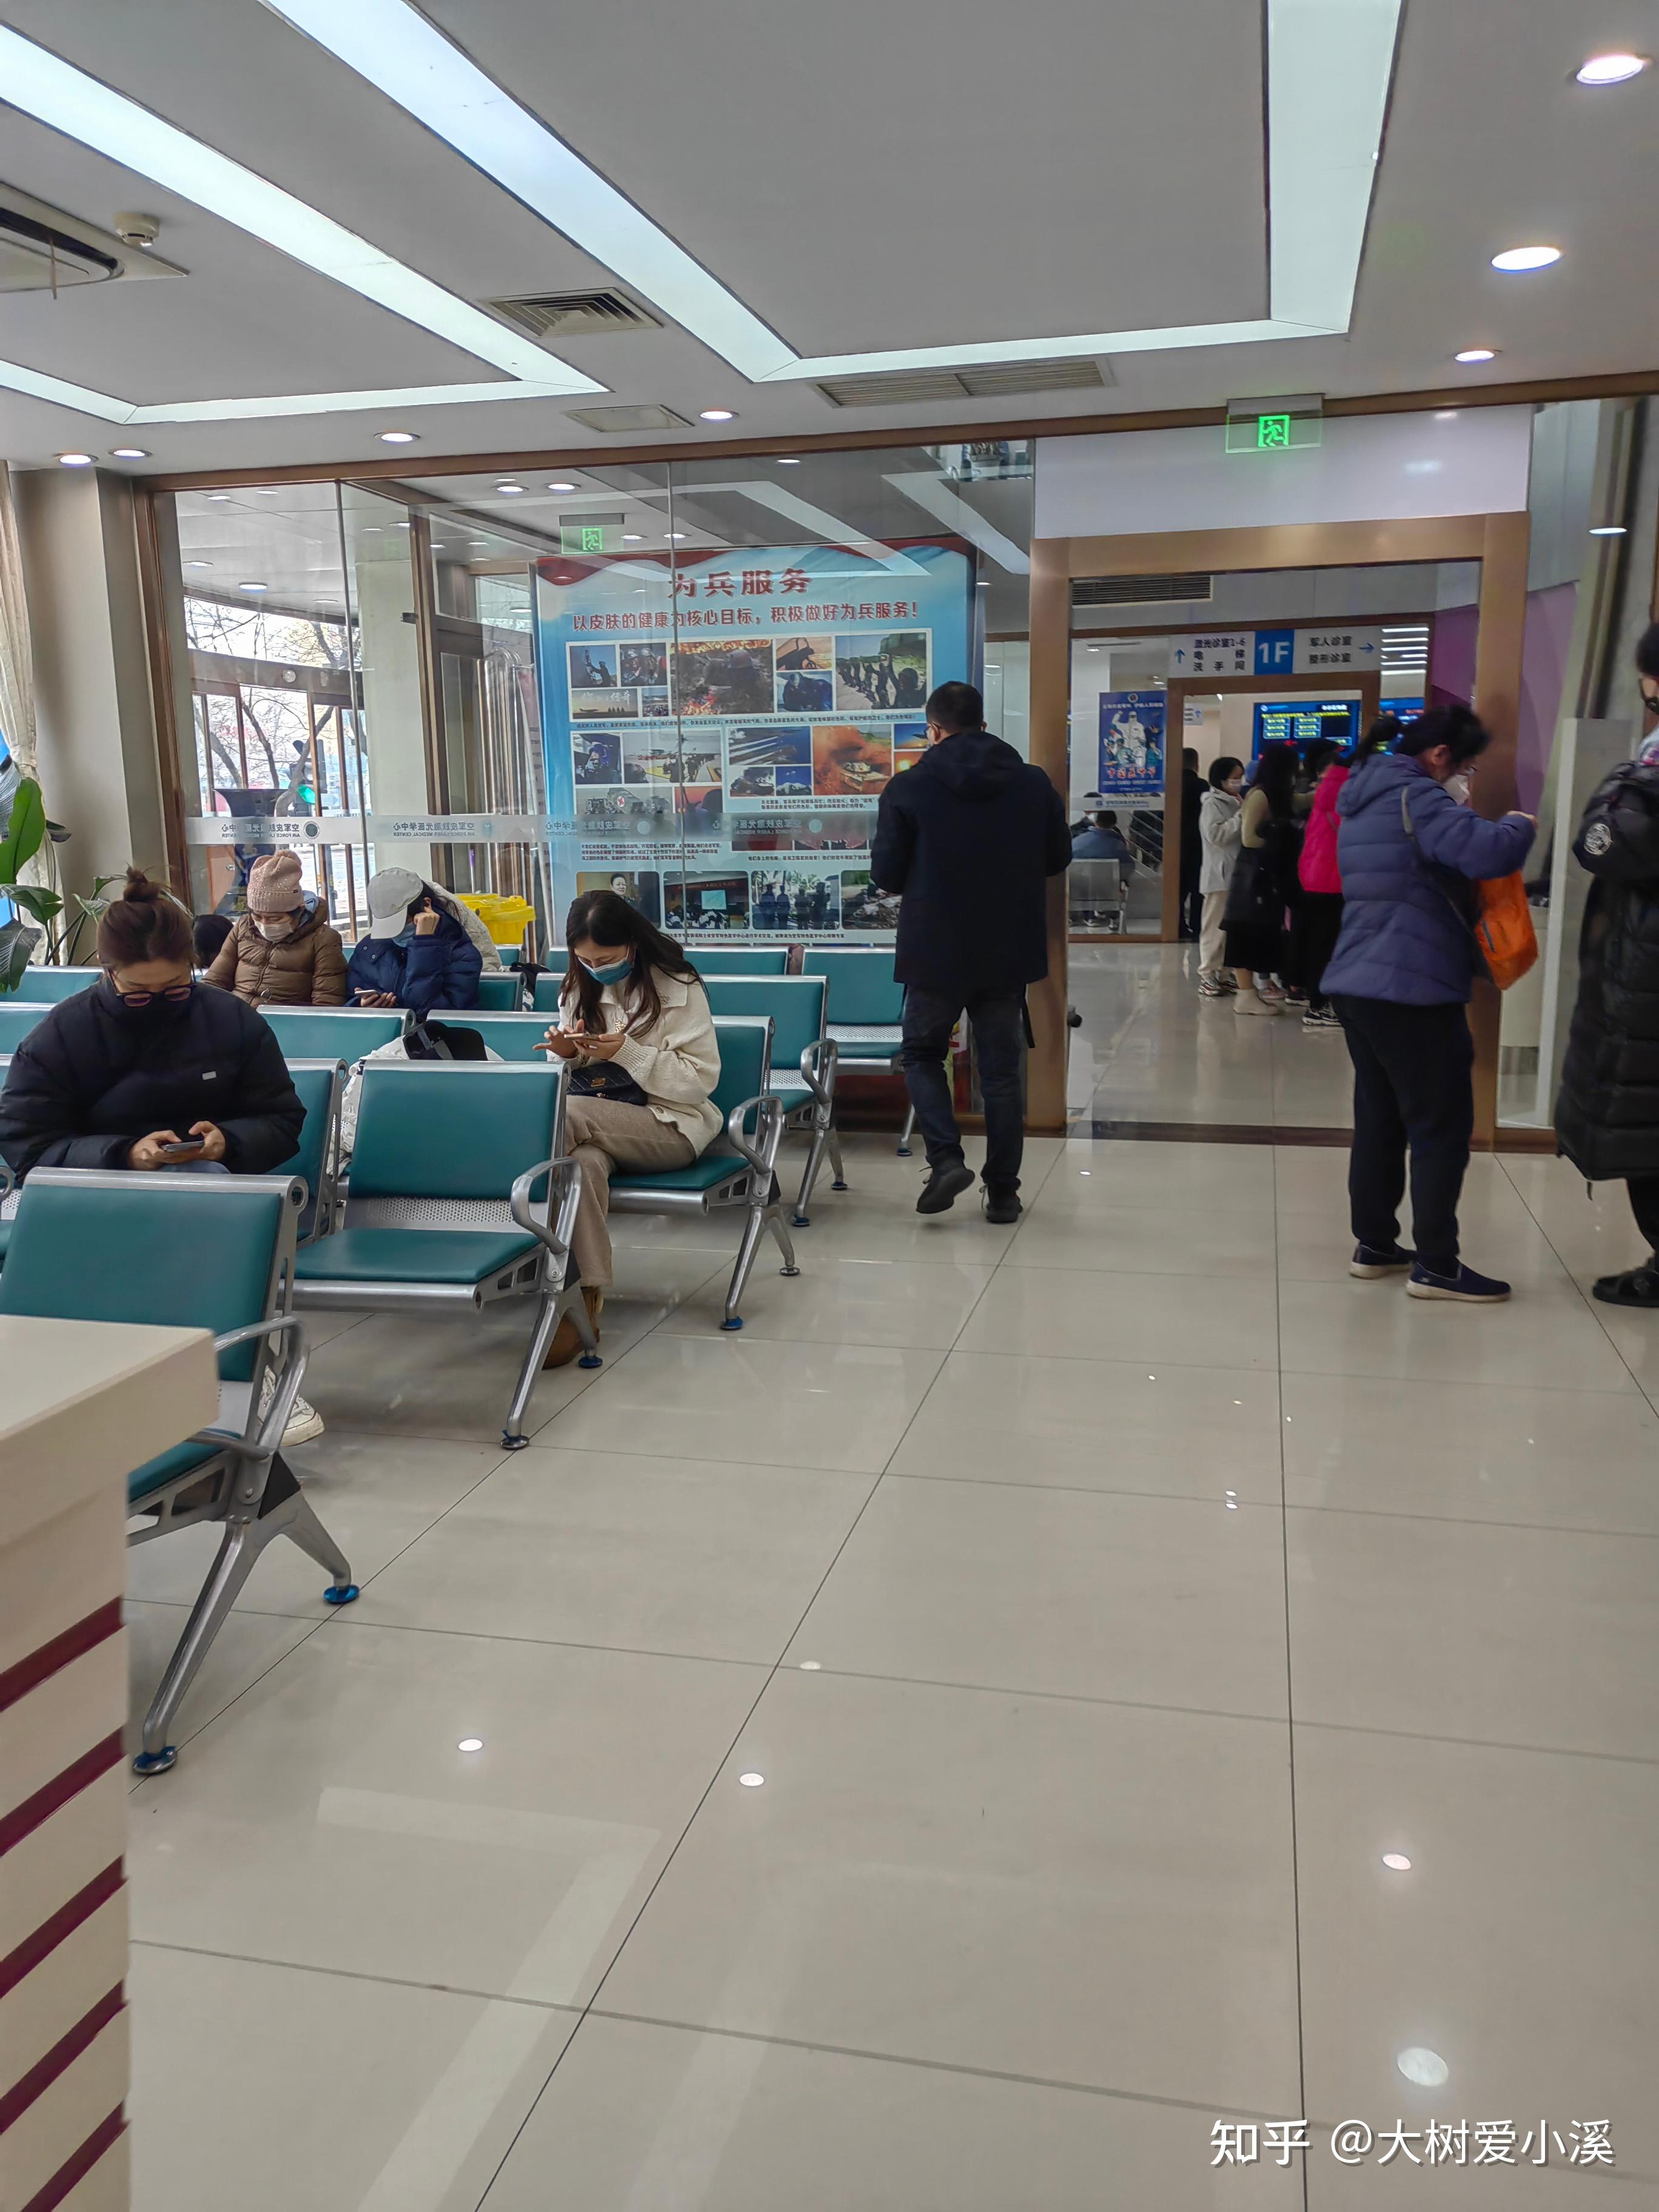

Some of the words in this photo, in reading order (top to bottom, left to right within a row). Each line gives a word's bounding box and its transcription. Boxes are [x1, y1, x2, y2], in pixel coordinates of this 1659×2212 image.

[668, 568, 813, 598] 为兵服务
[1259, 642, 1290, 663] 1F
